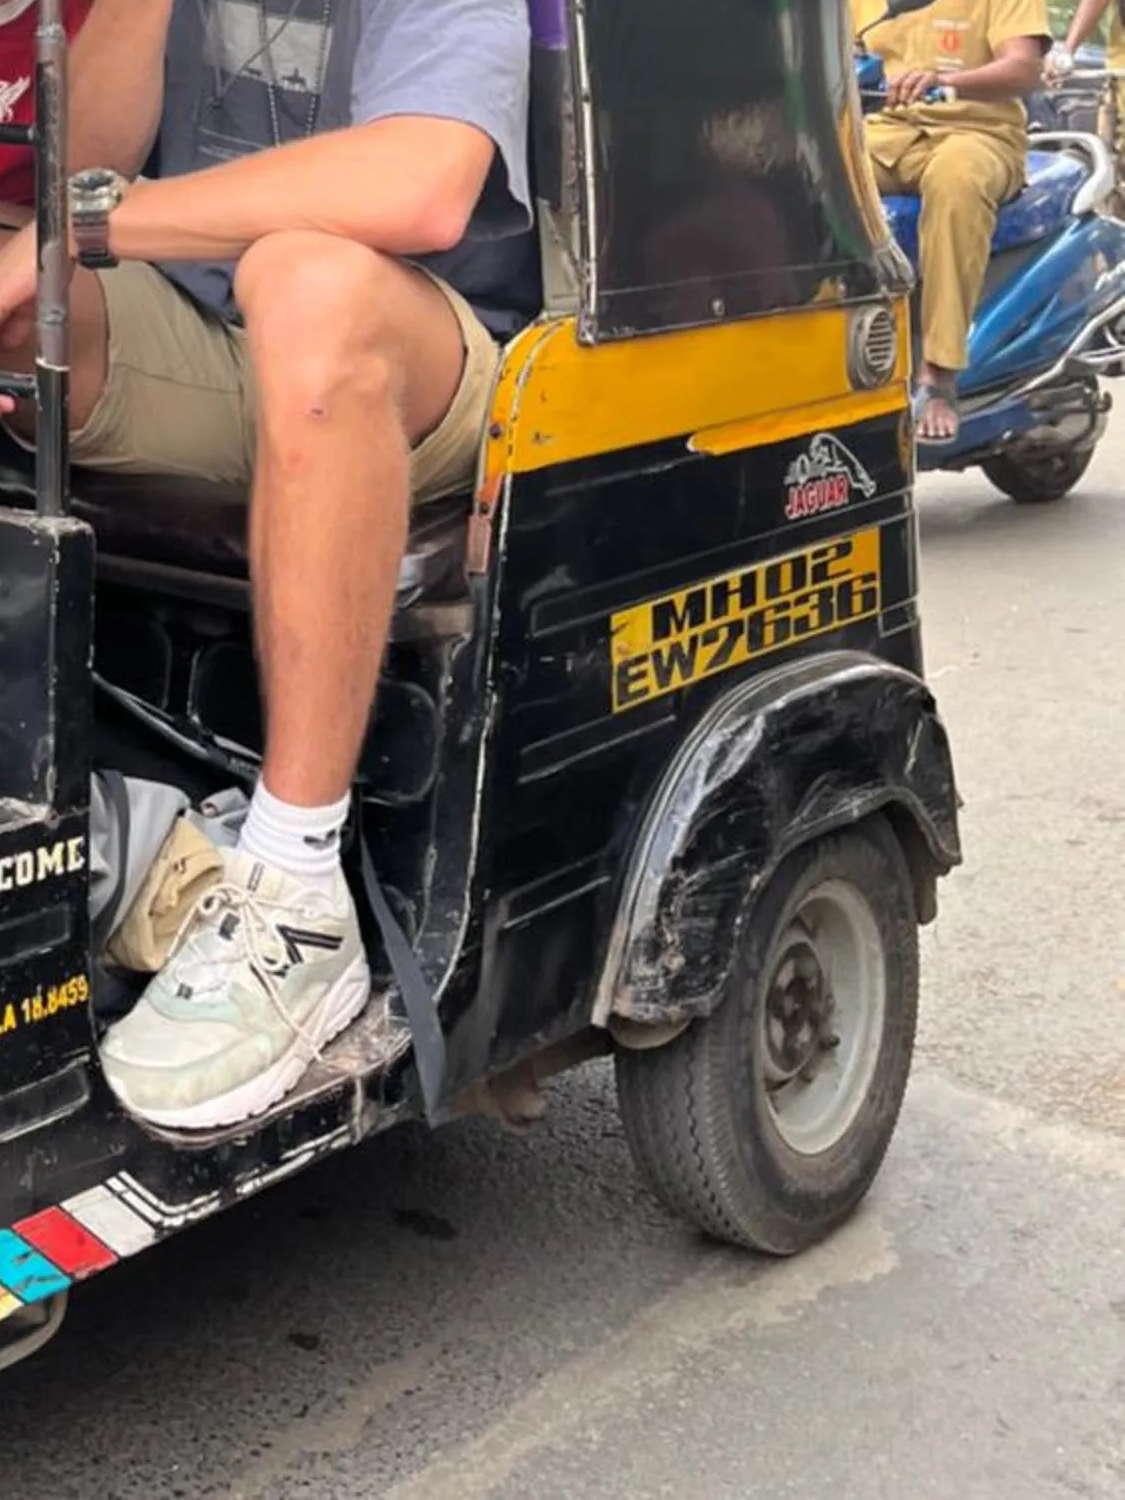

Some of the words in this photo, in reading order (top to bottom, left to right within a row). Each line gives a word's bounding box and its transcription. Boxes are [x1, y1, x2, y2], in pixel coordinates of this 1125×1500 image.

[784, 473, 848, 519] JAGUAR
[616, 572, 876, 704] EW7636
[651, 540, 852, 642] MH02
